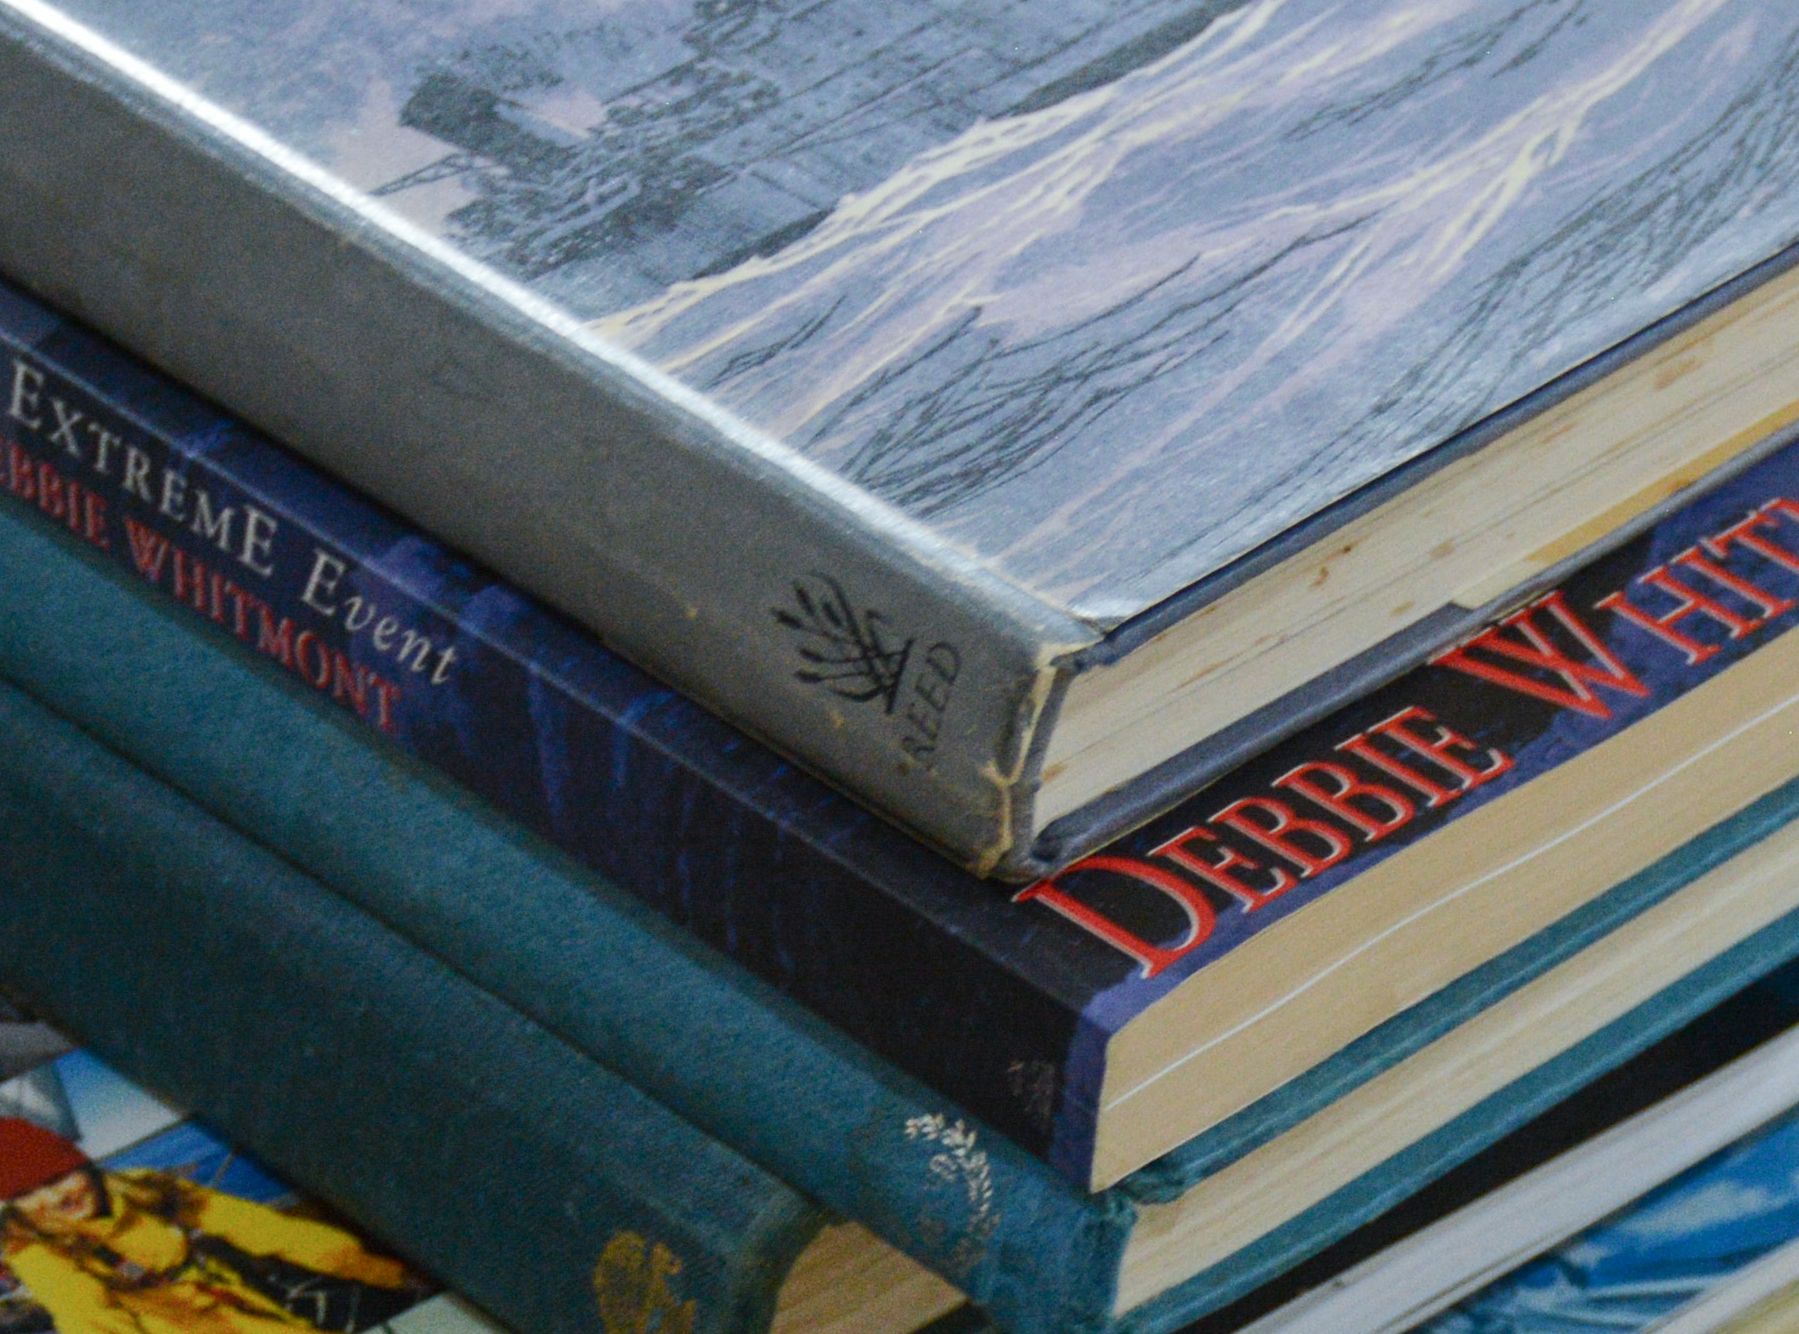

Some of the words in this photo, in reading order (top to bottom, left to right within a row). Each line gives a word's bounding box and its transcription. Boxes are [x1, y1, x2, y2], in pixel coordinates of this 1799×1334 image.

[8, 356, 281, 578] EXTREME
[300, 547, 462, 687] Event
[124, 514, 404, 734] WHITMONT
[1010, 703, 1521, 981] DEBBIE
